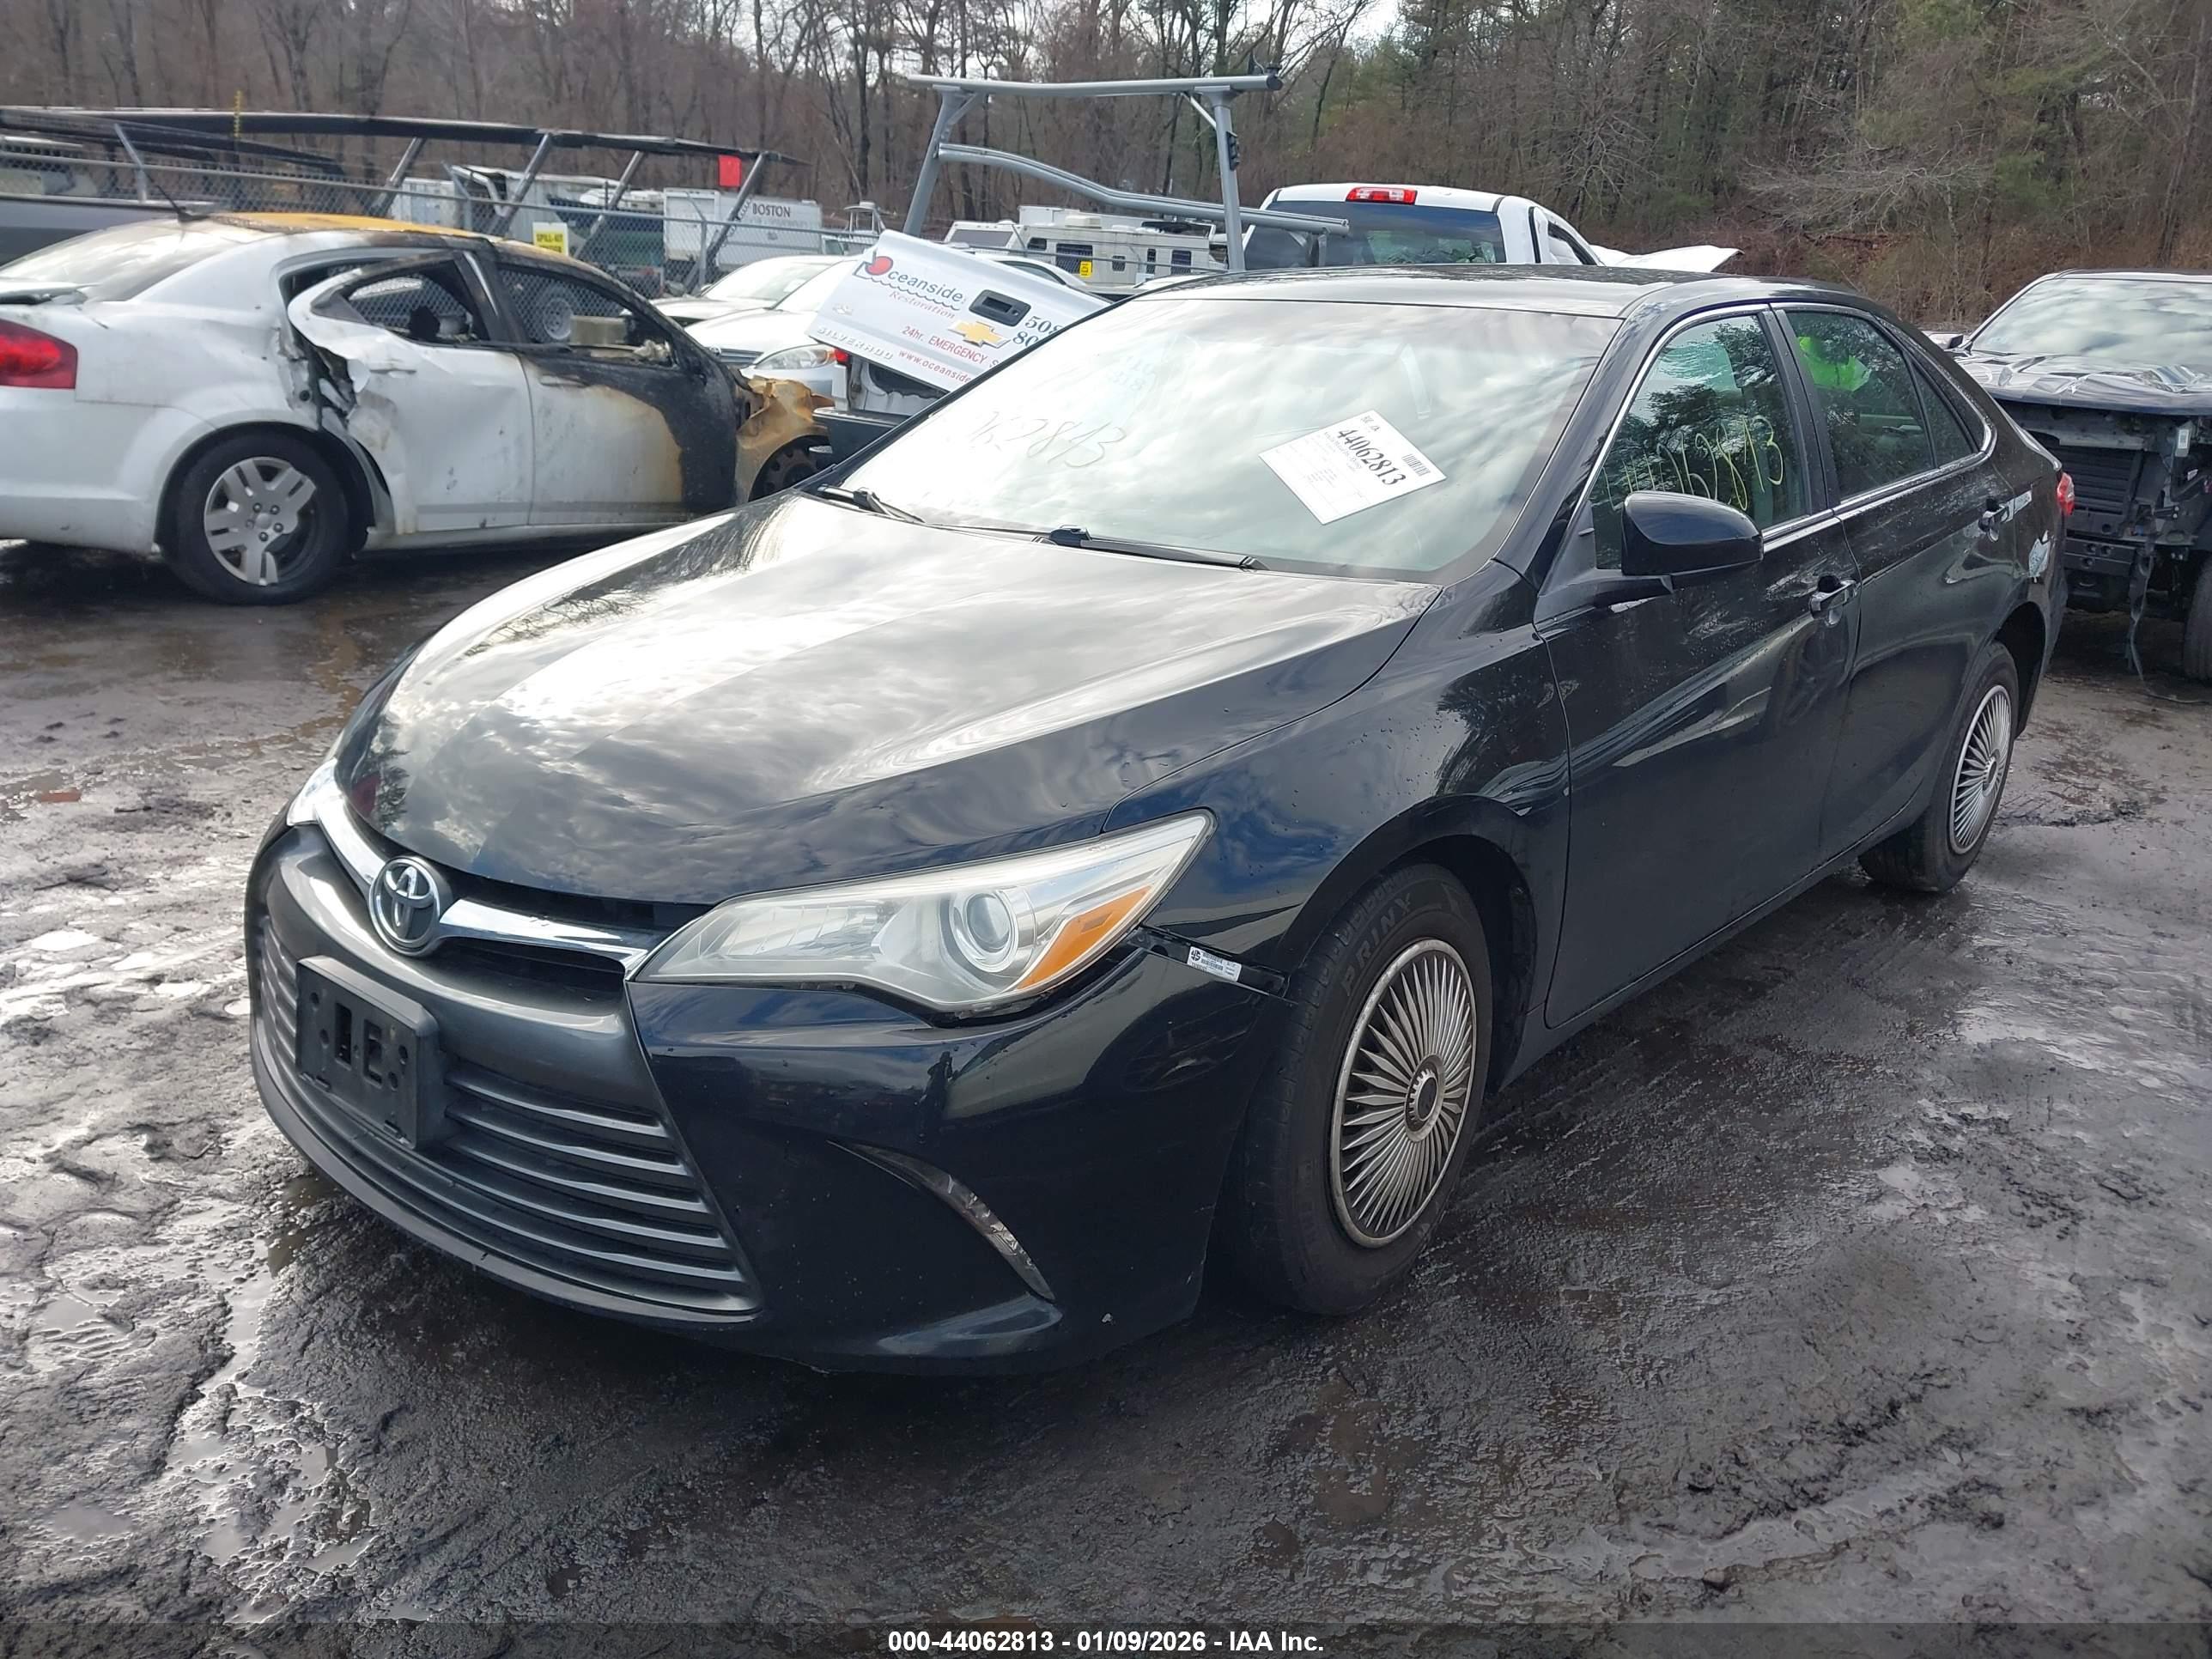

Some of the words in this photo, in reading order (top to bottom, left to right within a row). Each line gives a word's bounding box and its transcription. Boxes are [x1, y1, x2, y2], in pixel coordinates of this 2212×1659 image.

[752, 203, 791, 217] BOSTON
[902, 325, 924, 342] 24hr.
[928, 336, 988, 364] EMERGENCY
[1337, 429, 1407, 485] 44062813
